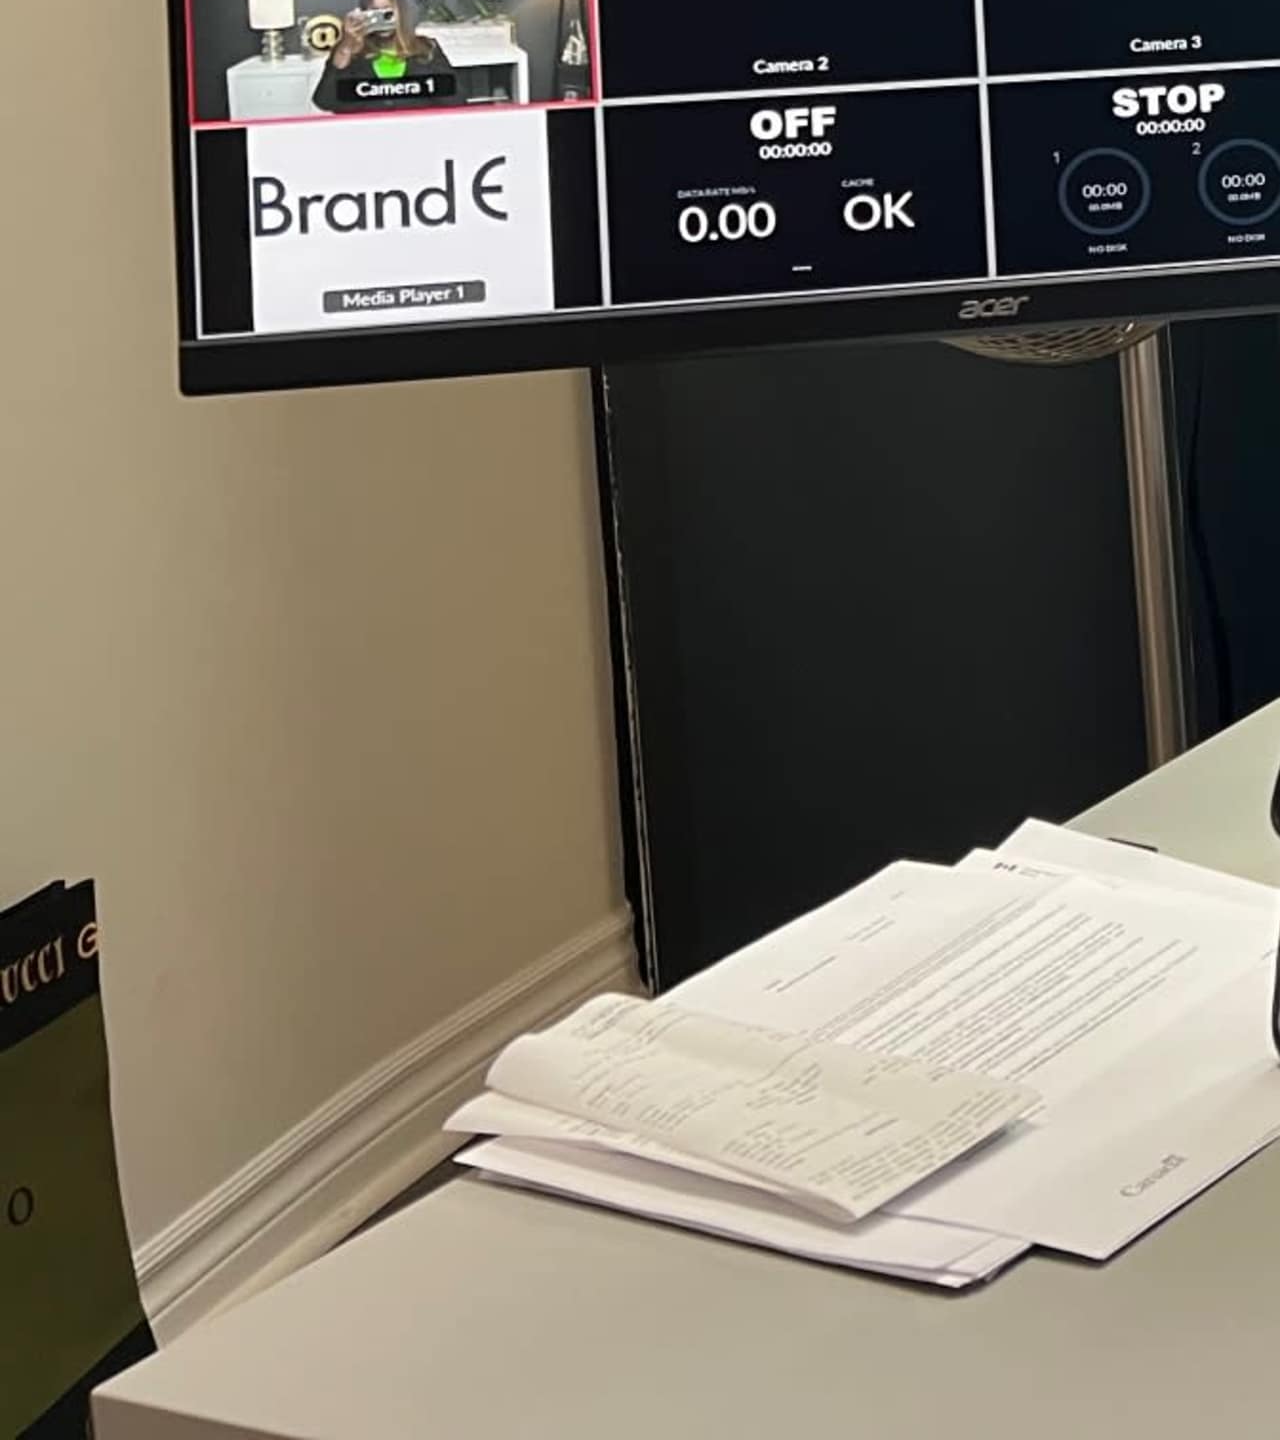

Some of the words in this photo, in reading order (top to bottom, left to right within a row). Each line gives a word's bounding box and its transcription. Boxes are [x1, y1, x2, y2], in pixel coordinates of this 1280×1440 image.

[1129, 36, 1189, 53] Camera
[1191, 34, 1203, 50] 3
[752, 58, 815, 75] Camera
[817, 56, 830, 72] 2
[355, 80, 420, 98] Camera
[425, 78, 435, 94] 1
[1112, 82, 1226, 118] STOP
[750, 105, 837, 141] OFF
[1135, 117, 1206, 136] 00:00:00
[758, 141, 833, 160] 00:00:00
[1052, 151, 1060, 165] 1
[1191, 141, 1202, 156] 2
[1221, 172, 1266, 189] 00:00
[1081, 182, 1128, 199] 00:00
[842, 189, 916, 232] OK
[677, 200, 777, 244] 0.00
[342, 291, 396, 309] Media
[399, 288, 454, 307] Player
[456, 285, 465, 301] 1
[958, 295, 1031, 319] acer
[0, 936, 65, 1004] UCCI
